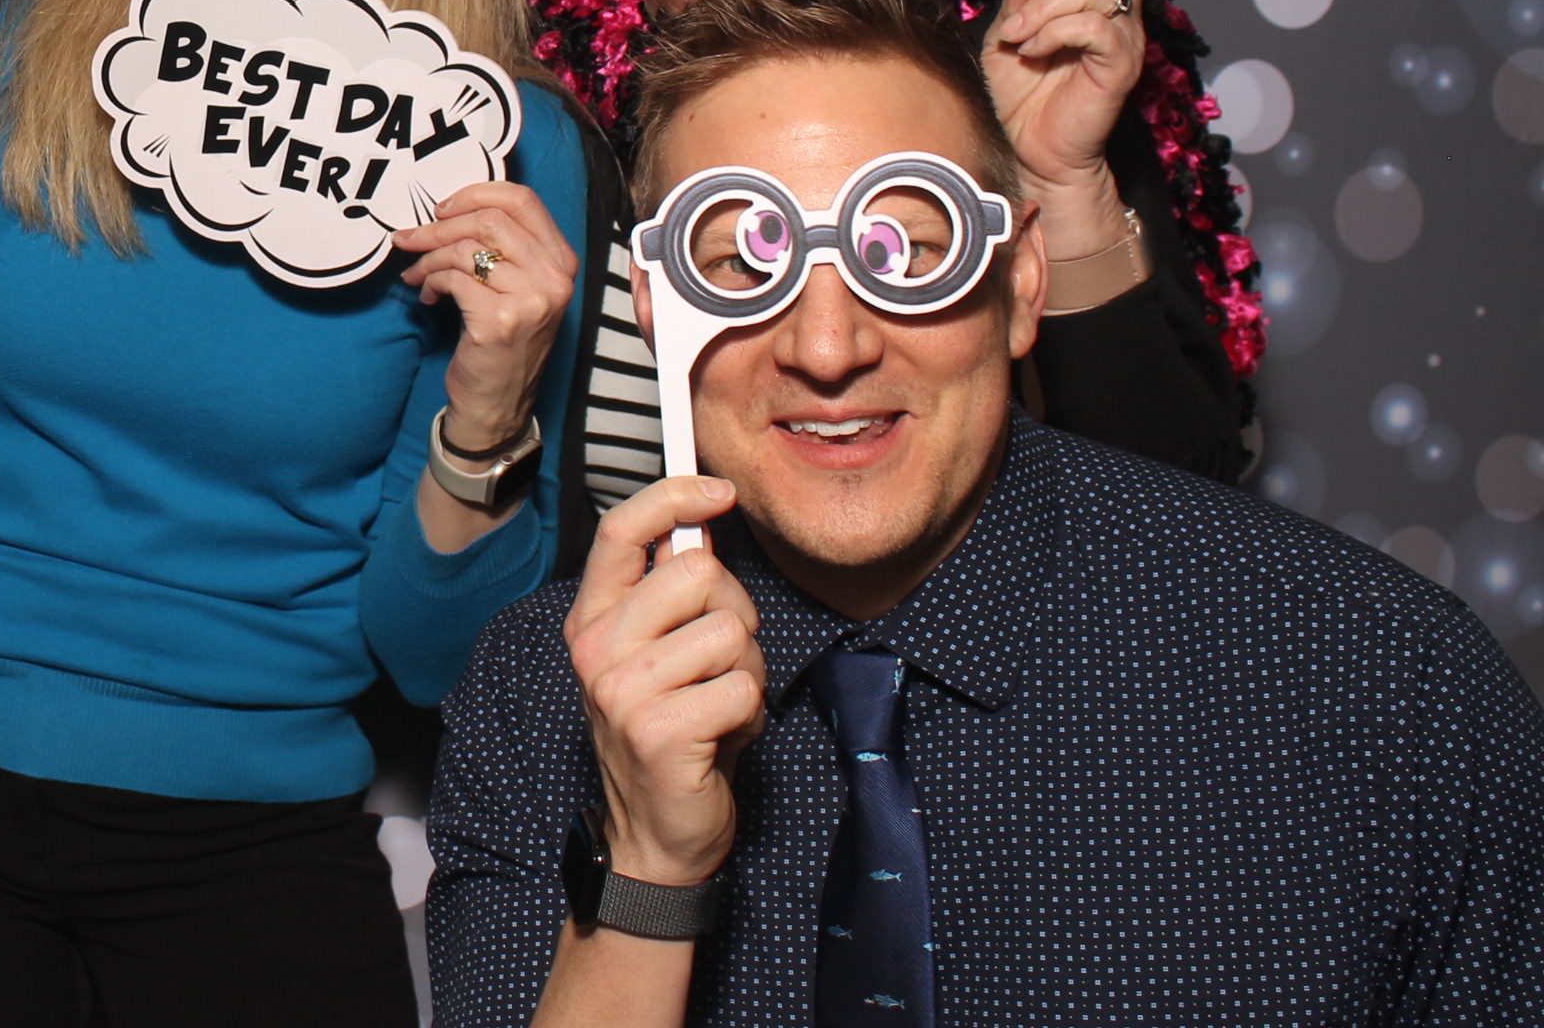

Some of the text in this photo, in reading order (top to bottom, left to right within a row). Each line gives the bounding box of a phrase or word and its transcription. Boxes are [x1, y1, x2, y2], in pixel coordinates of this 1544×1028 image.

[157, 21, 470, 162] BEST DAY
[202, 105, 390, 218] EVER!
